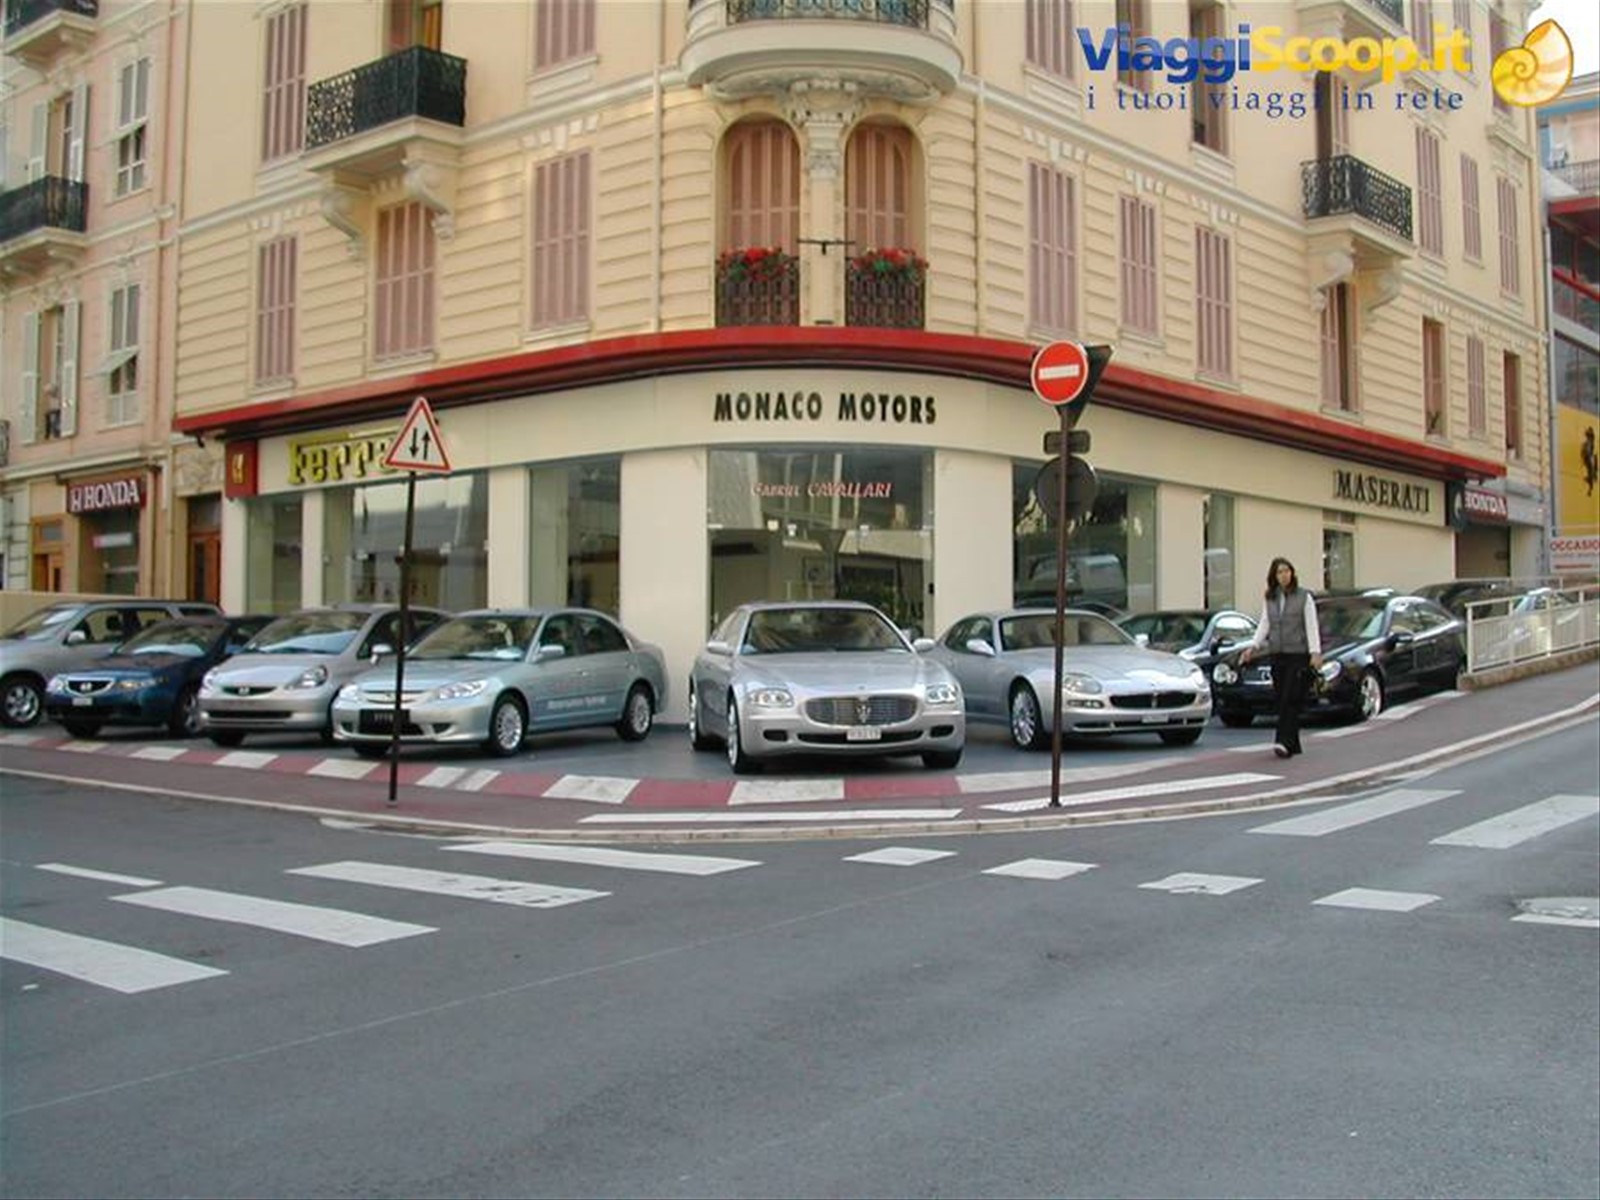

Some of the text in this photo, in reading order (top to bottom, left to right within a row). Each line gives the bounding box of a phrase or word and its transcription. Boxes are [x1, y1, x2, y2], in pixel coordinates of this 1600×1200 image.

[713, 390, 937, 425] MONACO MOTORS
[288, 424, 404, 485] Ferra
[84, 479, 140, 511] HONDA
[1333, 469, 1431, 513] MASERATI
